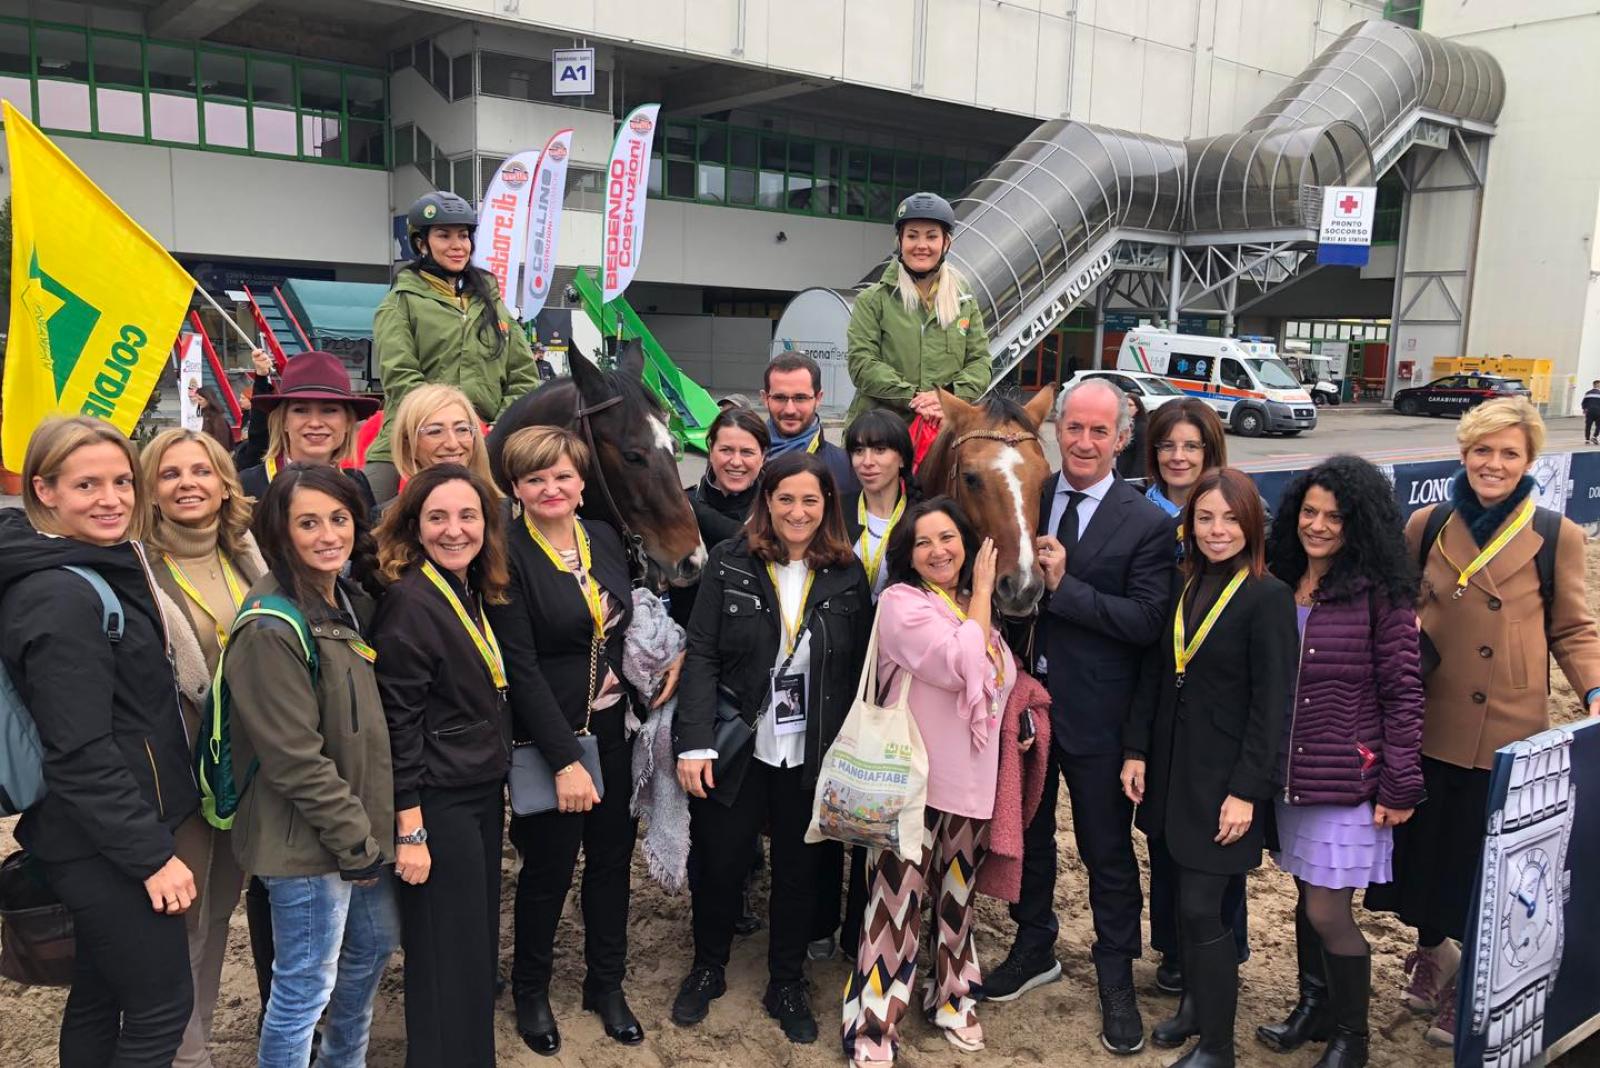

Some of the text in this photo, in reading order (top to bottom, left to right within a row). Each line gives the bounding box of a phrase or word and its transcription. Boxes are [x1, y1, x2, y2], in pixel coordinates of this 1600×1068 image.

[560, 65, 586, 81] A1
[486, 192, 518, 304] store.it
[605, 159, 625, 290] BEDENDO
[619, 138, 641, 268] Costruzioni
[804, 347, 848, 361] eronafiere
[1008, 251, 1112, 359] SCALA NORD
[838, 759, 909, 784] MANGIAFIABE
